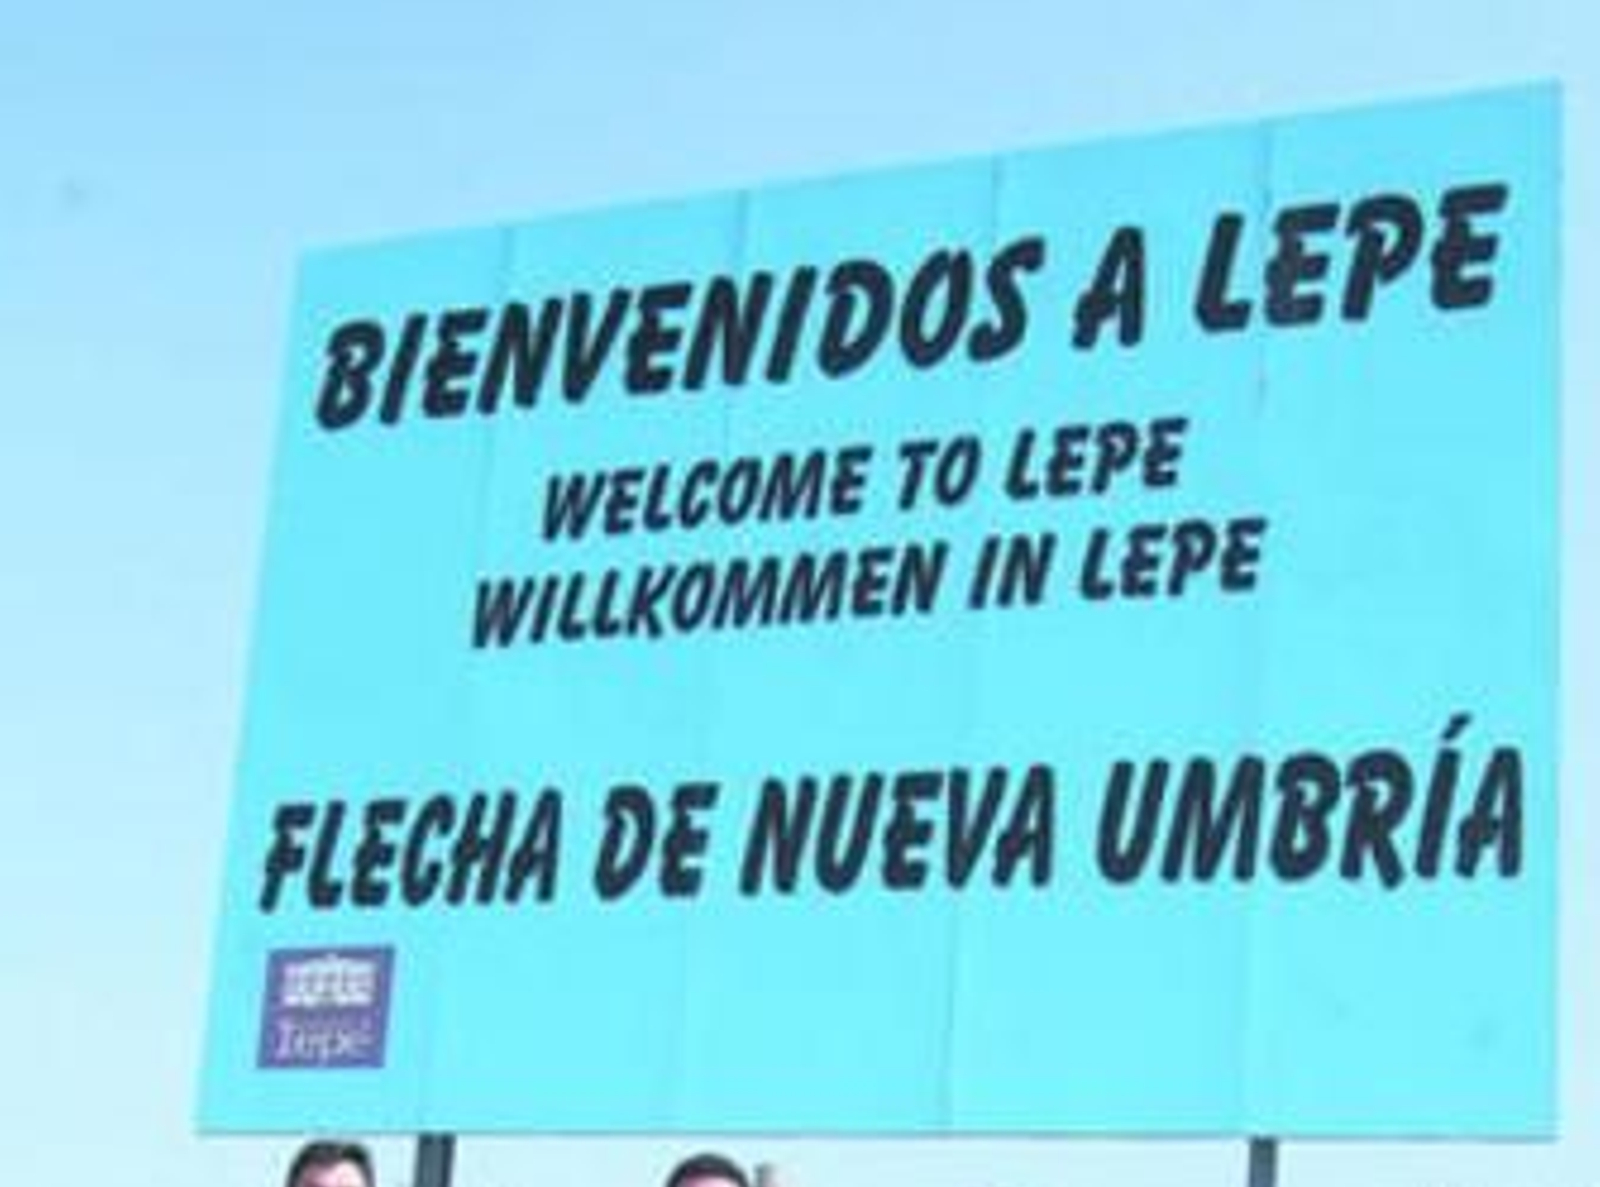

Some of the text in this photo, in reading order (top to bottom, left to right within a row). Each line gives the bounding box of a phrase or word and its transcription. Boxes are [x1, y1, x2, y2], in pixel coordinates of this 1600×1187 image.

[315, 182, 1510, 433] BIENVENIDOS A LEPE
[542, 416, 1188, 542] WELCOME TO LEPE
[472, 517, 1267, 650] WILLKOMMEN IN LEPE
[259, 713, 1524, 913] FLECHA DE NUEVA UMBRÍA
